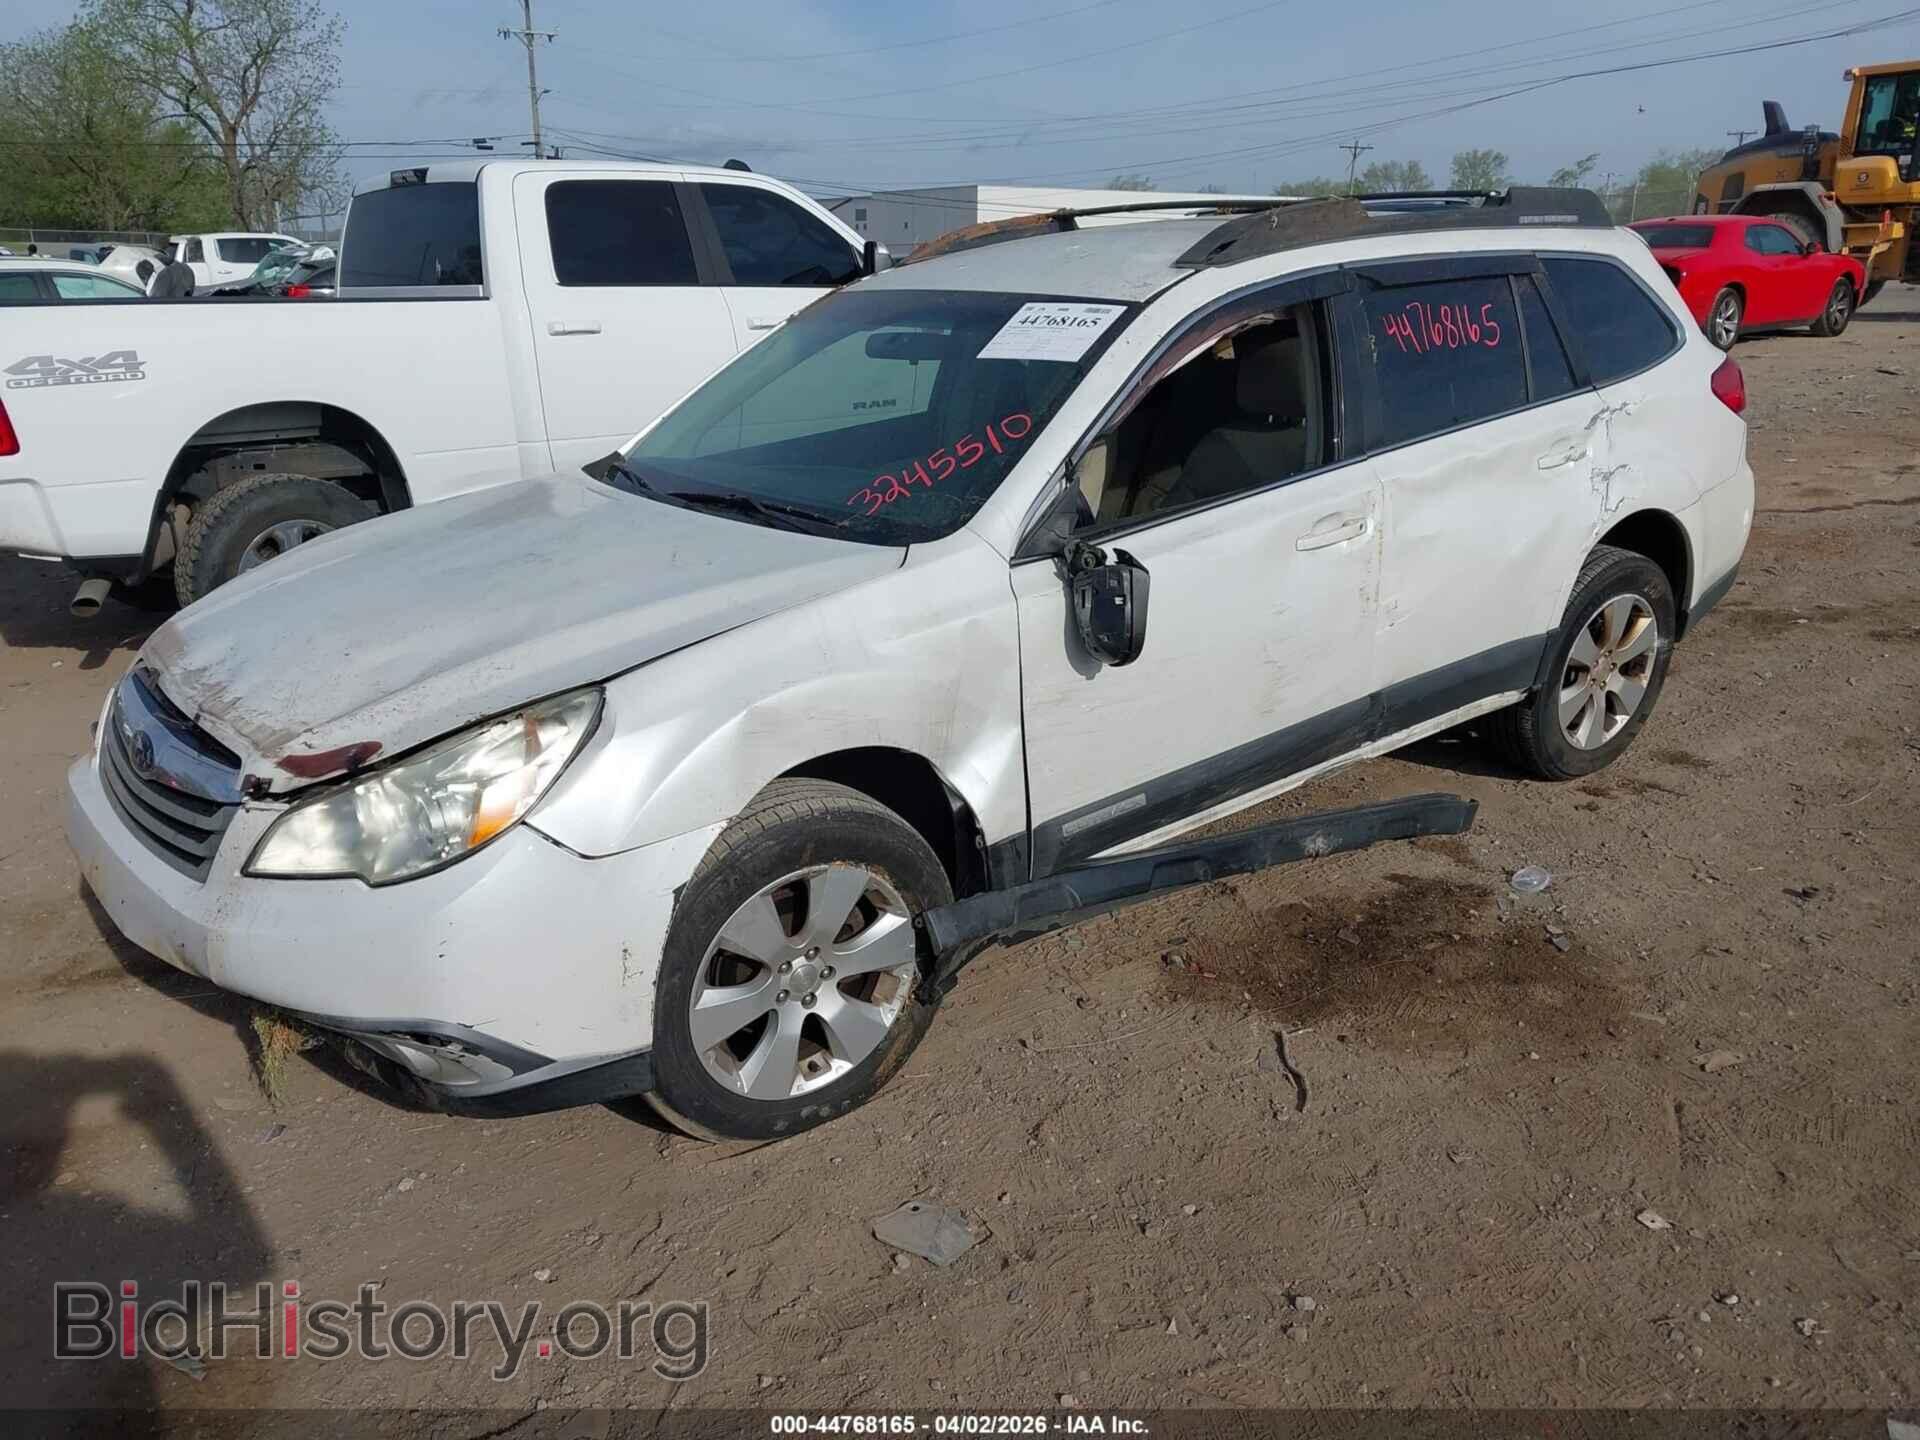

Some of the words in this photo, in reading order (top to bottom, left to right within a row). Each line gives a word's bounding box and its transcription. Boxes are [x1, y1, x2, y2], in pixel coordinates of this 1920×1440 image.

[1018, 315, 1101, 328] 44768165
[1382, 302, 1500, 353] 44768165
[8, 378, 66, 387] OFF
[69, 372, 144, 384] ROAD
[852, 400, 897, 410] RAM
[847, 413, 1032, 516] 3245510
